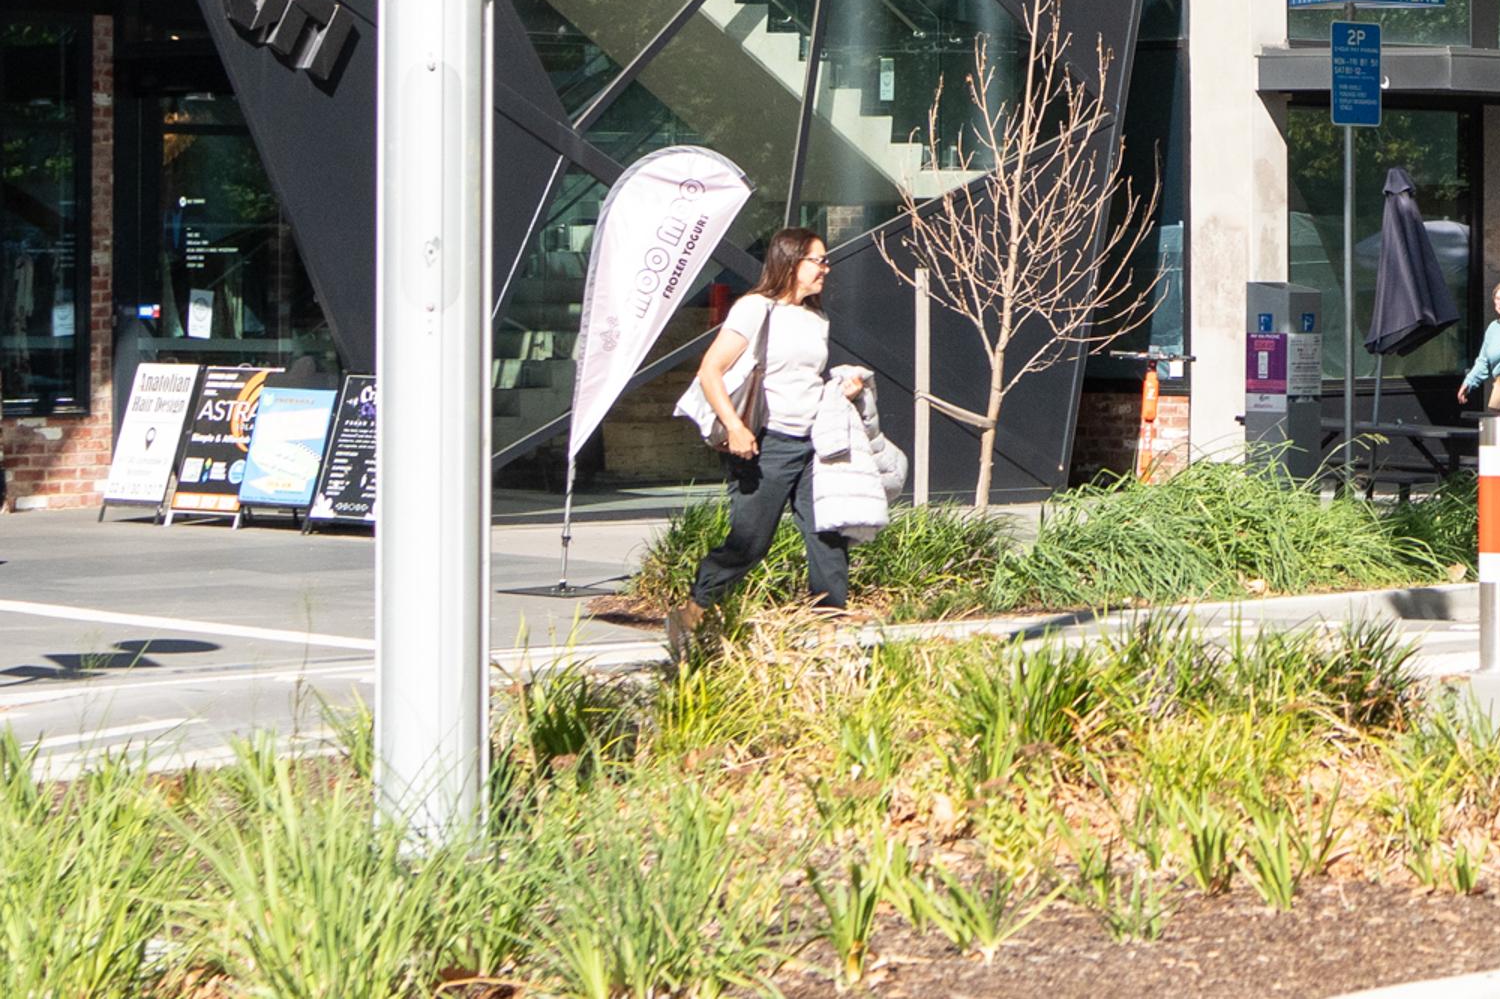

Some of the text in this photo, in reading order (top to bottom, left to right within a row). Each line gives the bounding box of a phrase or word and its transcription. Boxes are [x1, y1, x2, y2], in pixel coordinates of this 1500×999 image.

[1347, 29, 1366, 46] 2P
[662, 214, 709, 299] FROZEN YOGURT
[131, 396, 153, 413] Hair
